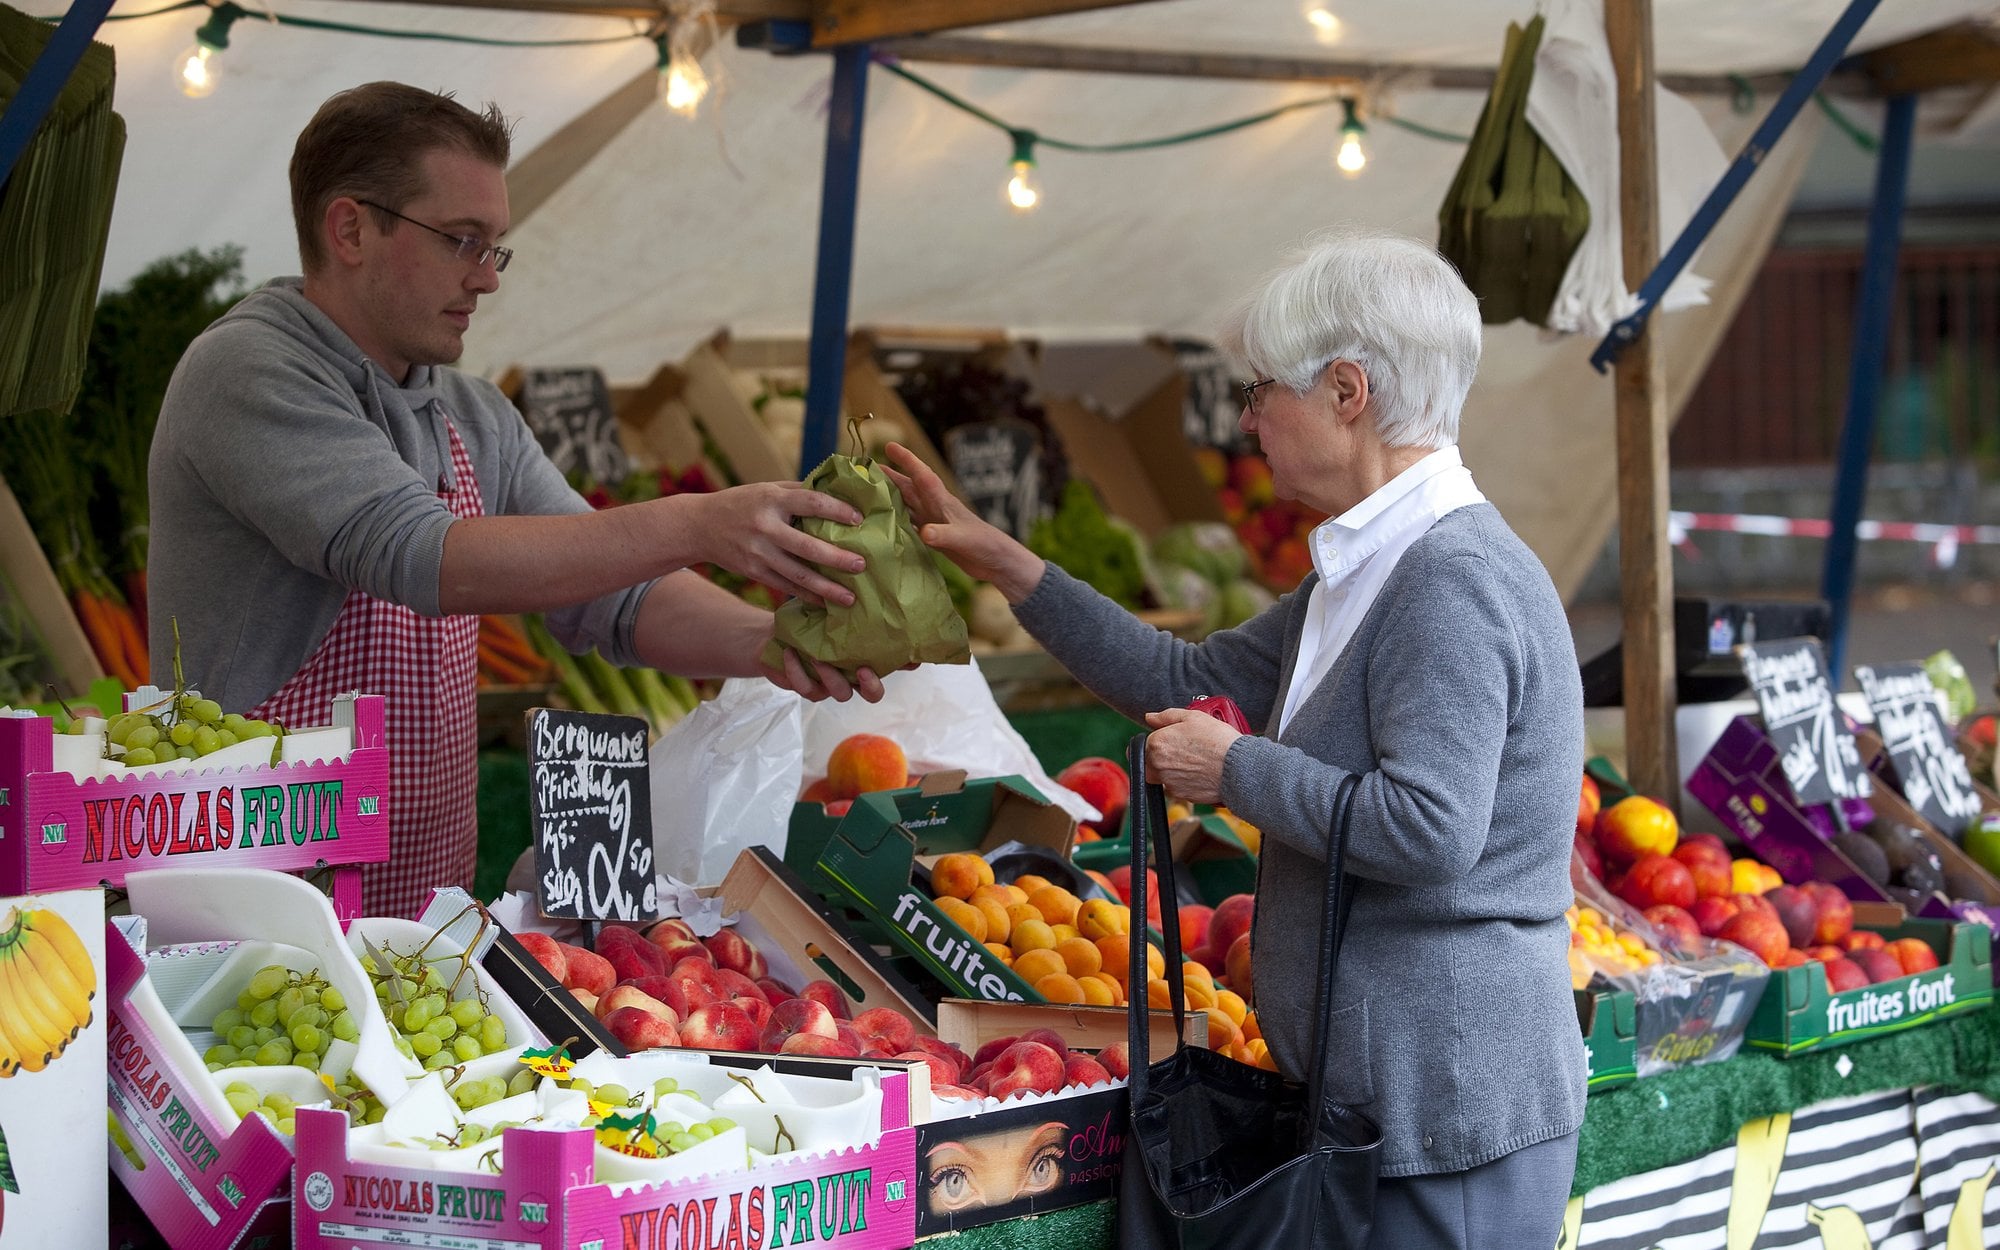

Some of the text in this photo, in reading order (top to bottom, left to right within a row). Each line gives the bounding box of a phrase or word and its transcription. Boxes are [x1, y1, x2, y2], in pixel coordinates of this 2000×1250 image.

[535, 710, 646, 768] Bergware
[82, 780, 344, 864] NICOLAS FRUIT
[1826, 972, 1956, 1033] fruites font
[159, 1095, 221, 1174] FRUIT
[343, 1175, 433, 1214] NICOLAS
[437, 1184, 507, 1222] FRUIT
[620, 1168, 872, 1250] NICOLAS FRUIT
